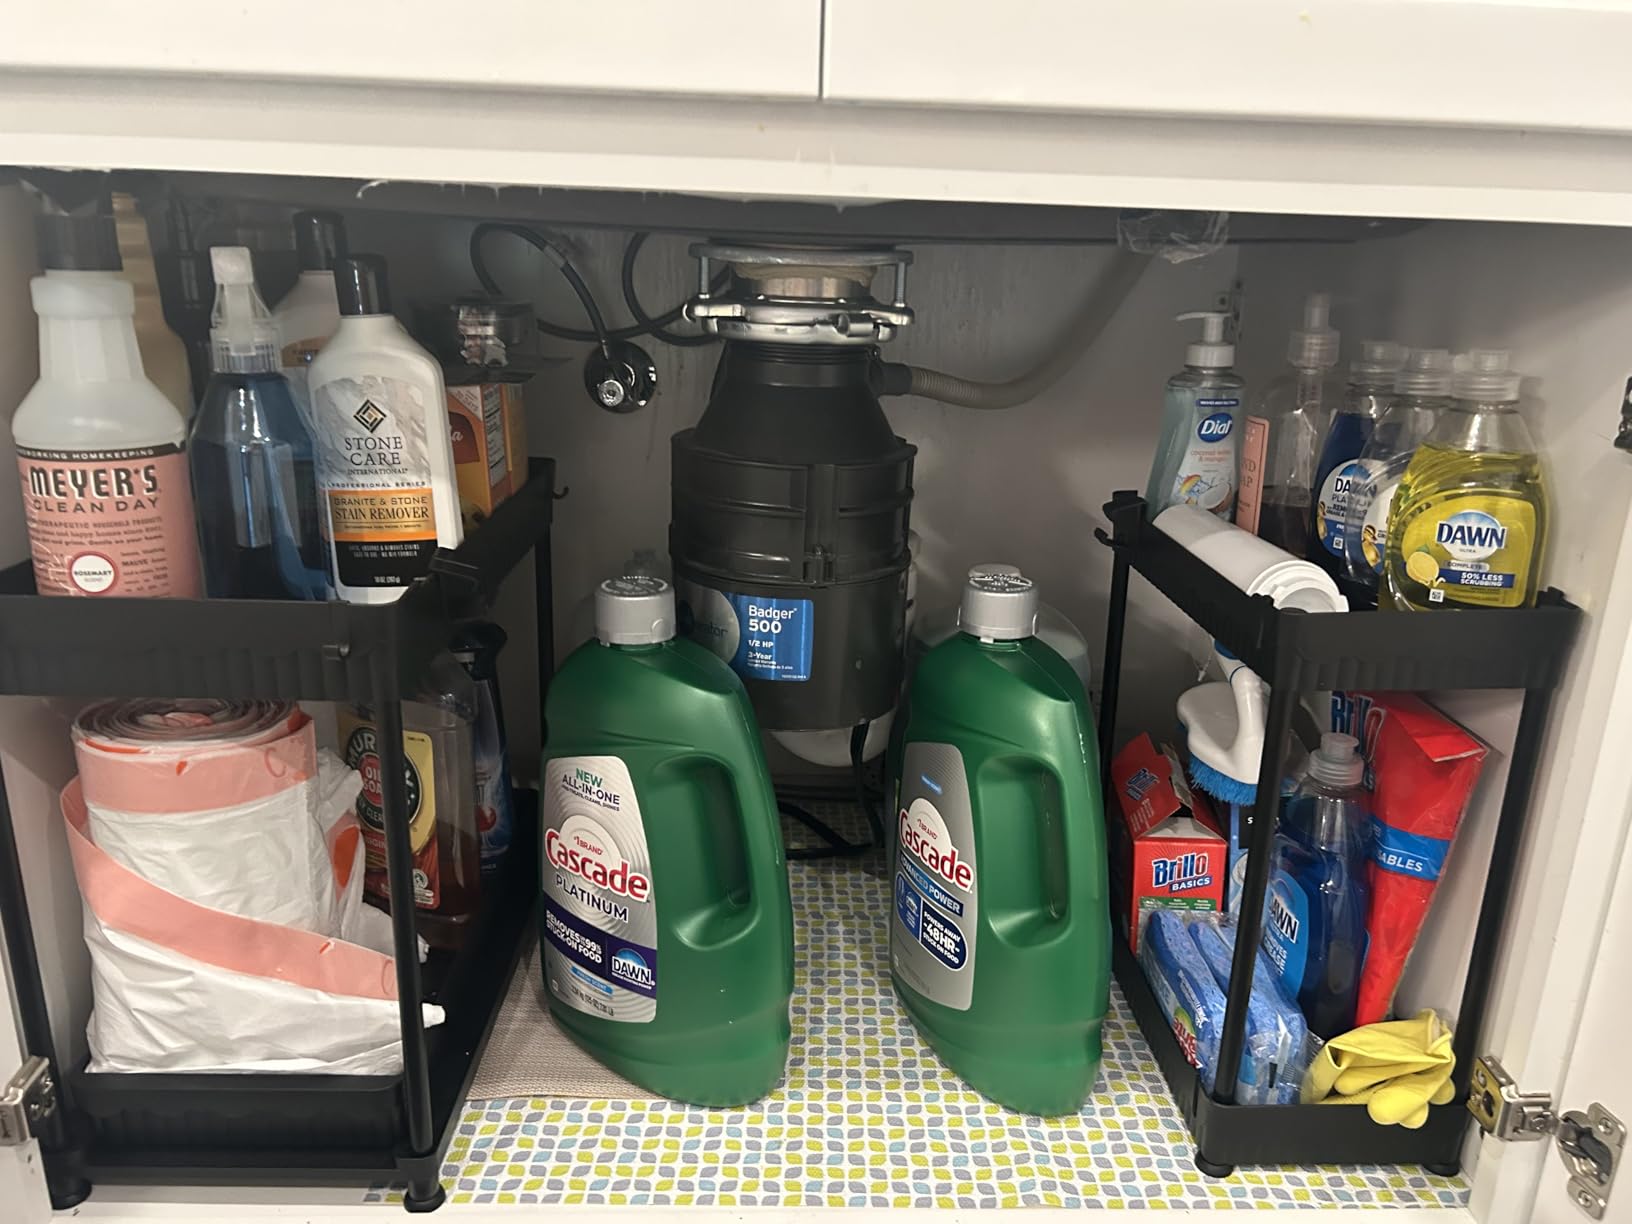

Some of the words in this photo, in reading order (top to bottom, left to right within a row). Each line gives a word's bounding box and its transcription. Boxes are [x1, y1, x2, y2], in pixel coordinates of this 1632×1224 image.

[1200, 419, 1233, 435] Dial
[345, 436, 403, 451] STONE
[72, 448, 154, 460] HOMEKEEPING
[350, 452, 401, 466] CARE
[347, 467, 408, 476] INTERNATIONAL
[331, 481, 391, 489] PROFESSIONAL
[395, 480, 426, 488] SERIES
[33, 499, 105, 513] CLEAN
[115, 497, 160, 512] DAY
[334, 498, 376, 507] GRANITE
[391, 496, 428, 506] STONE
[335, 507, 367, 520] STAIN
[370, 505, 429, 520] REMOVER
[1436, 522, 1506, 548] DAWN
[1460, 579, 1504, 587] SCRUBBING
[1461, 572, 1480, 580] 50%
[1482, 573, 1504, 581] LESS
[748, 604, 797, 620] Badger
[748, 618, 782, 634] 500
[748, 640, 760, 648] 1/2
[748, 651, 773, 660] 3-Year
[576, 768, 603, 788] NEW
[562, 774, 620, 805] ALL-IN-ONE
[899, 809, 972, 889] Cascade
[545, 829, 650, 900] Cascade
[1152, 853, 1208, 888] Brillo
[1172, 877, 1210, 892] BASICS
[556, 875, 628, 922] PLATINUM
[928, 885, 960, 914] POWER
[546, 910, 580, 942] REMOVES
[923, 910, 945, 933] POWERS
[944, 926, 961, 943] AWAY
[546, 919, 578, 951] STUCK-ON
[578, 944, 602, 963] FOOD
[922, 931, 937, 948] STUCK
[936, 943, 945, 955] ON
[944, 948, 960, 964] FOOD
[612, 957, 652, 984] DAWN
